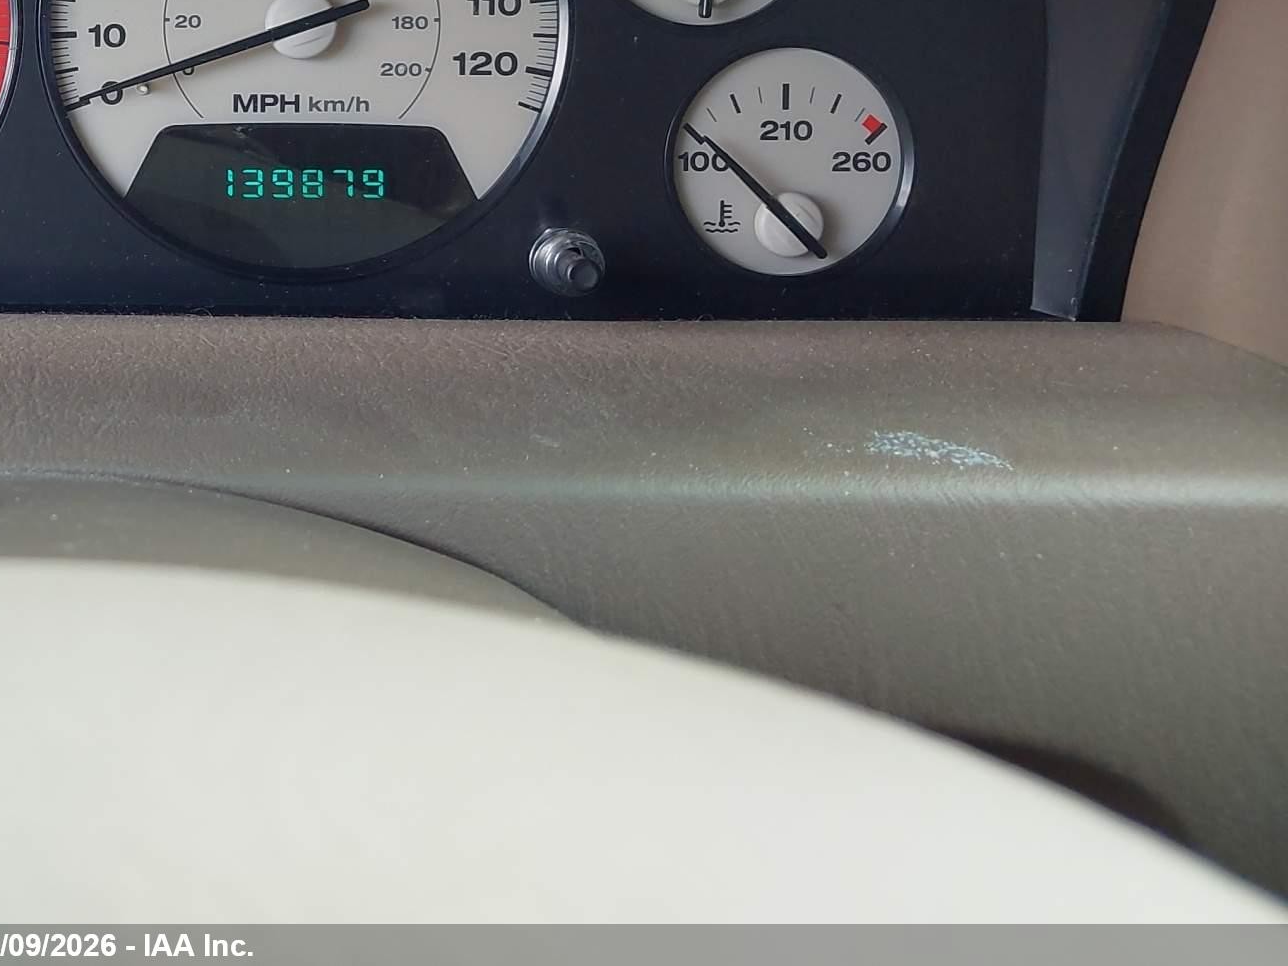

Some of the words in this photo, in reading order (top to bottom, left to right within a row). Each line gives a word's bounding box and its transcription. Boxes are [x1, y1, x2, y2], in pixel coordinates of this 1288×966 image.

[174, 14, 202, 29] 20
[391, 15, 429, 30] 180
[88, 23, 127, 48] 10
[381, 63, 422, 78] 200
[452, 51, 518, 77] 120
[233, 93, 300, 113] MPH
[308, 96, 370, 113] km/h
[759, 120, 813, 141] 210
[678, 151, 730, 172] 100
[831, 151, 892, 173] 260
[225, 169, 384, 198] 139879
